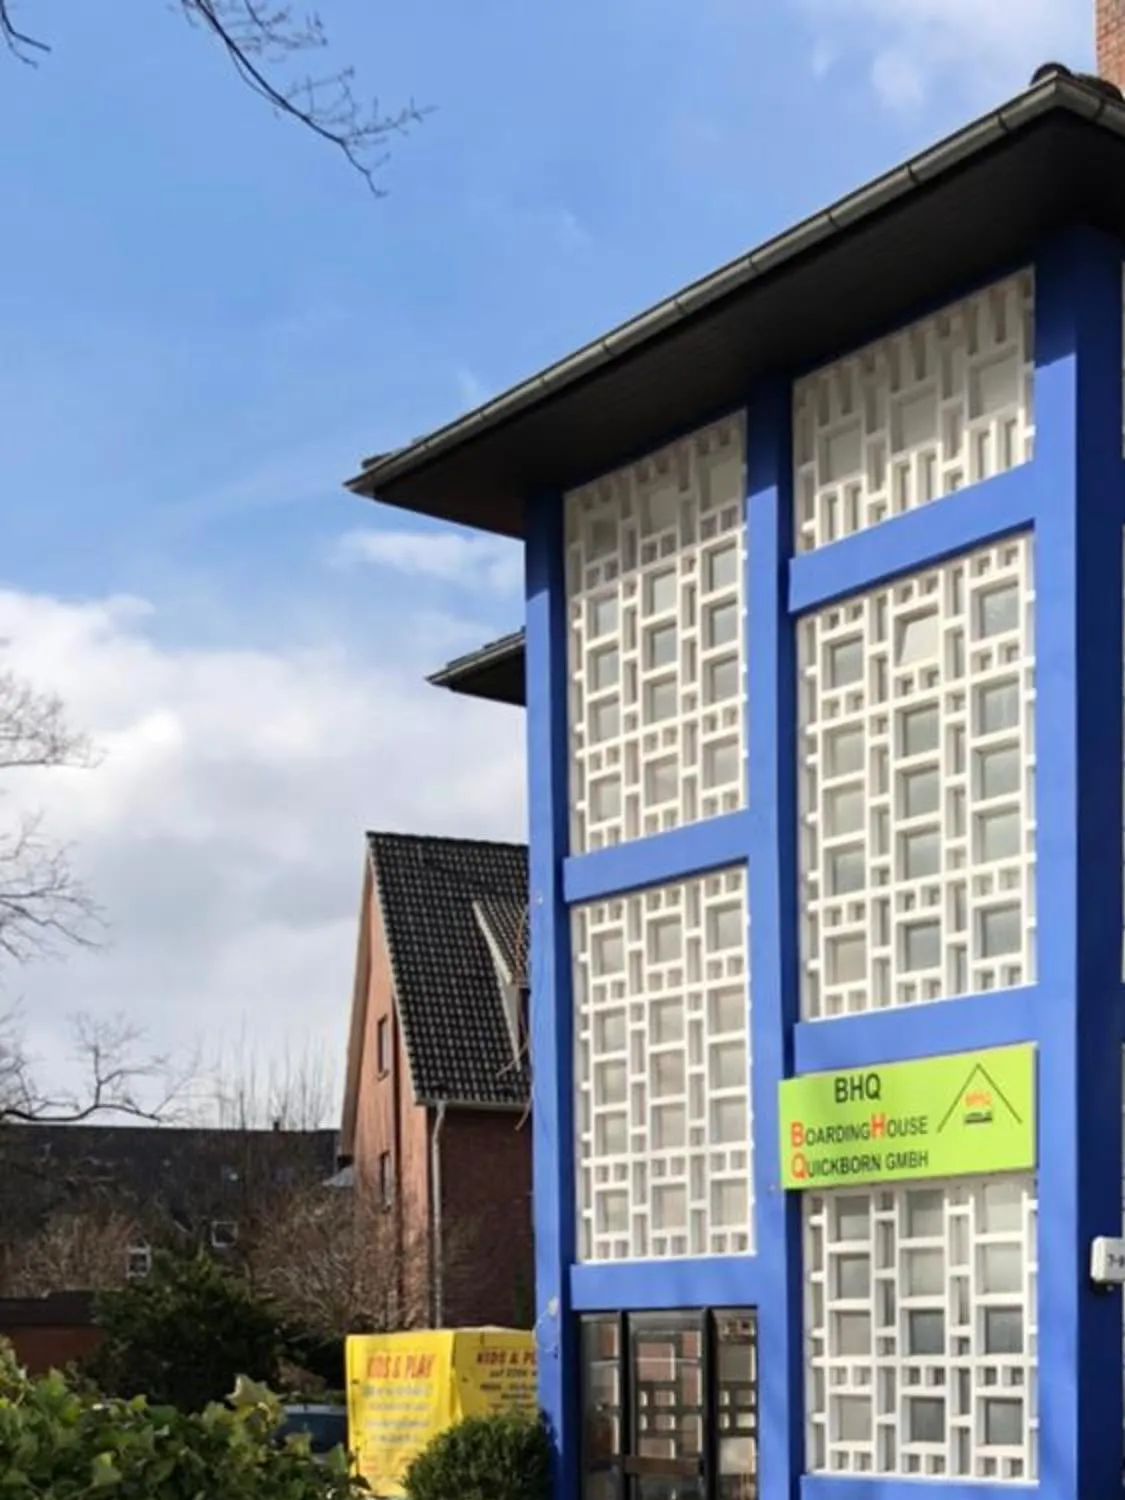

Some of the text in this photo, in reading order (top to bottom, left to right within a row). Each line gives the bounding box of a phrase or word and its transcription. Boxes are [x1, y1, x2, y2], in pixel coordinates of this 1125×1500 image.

[834, 1072, 882, 1104] BHQ
[789, 1112, 929, 1148] BOARDINGHOUSE
[790, 1149, 930, 1180] QUICKBORN GMBH
